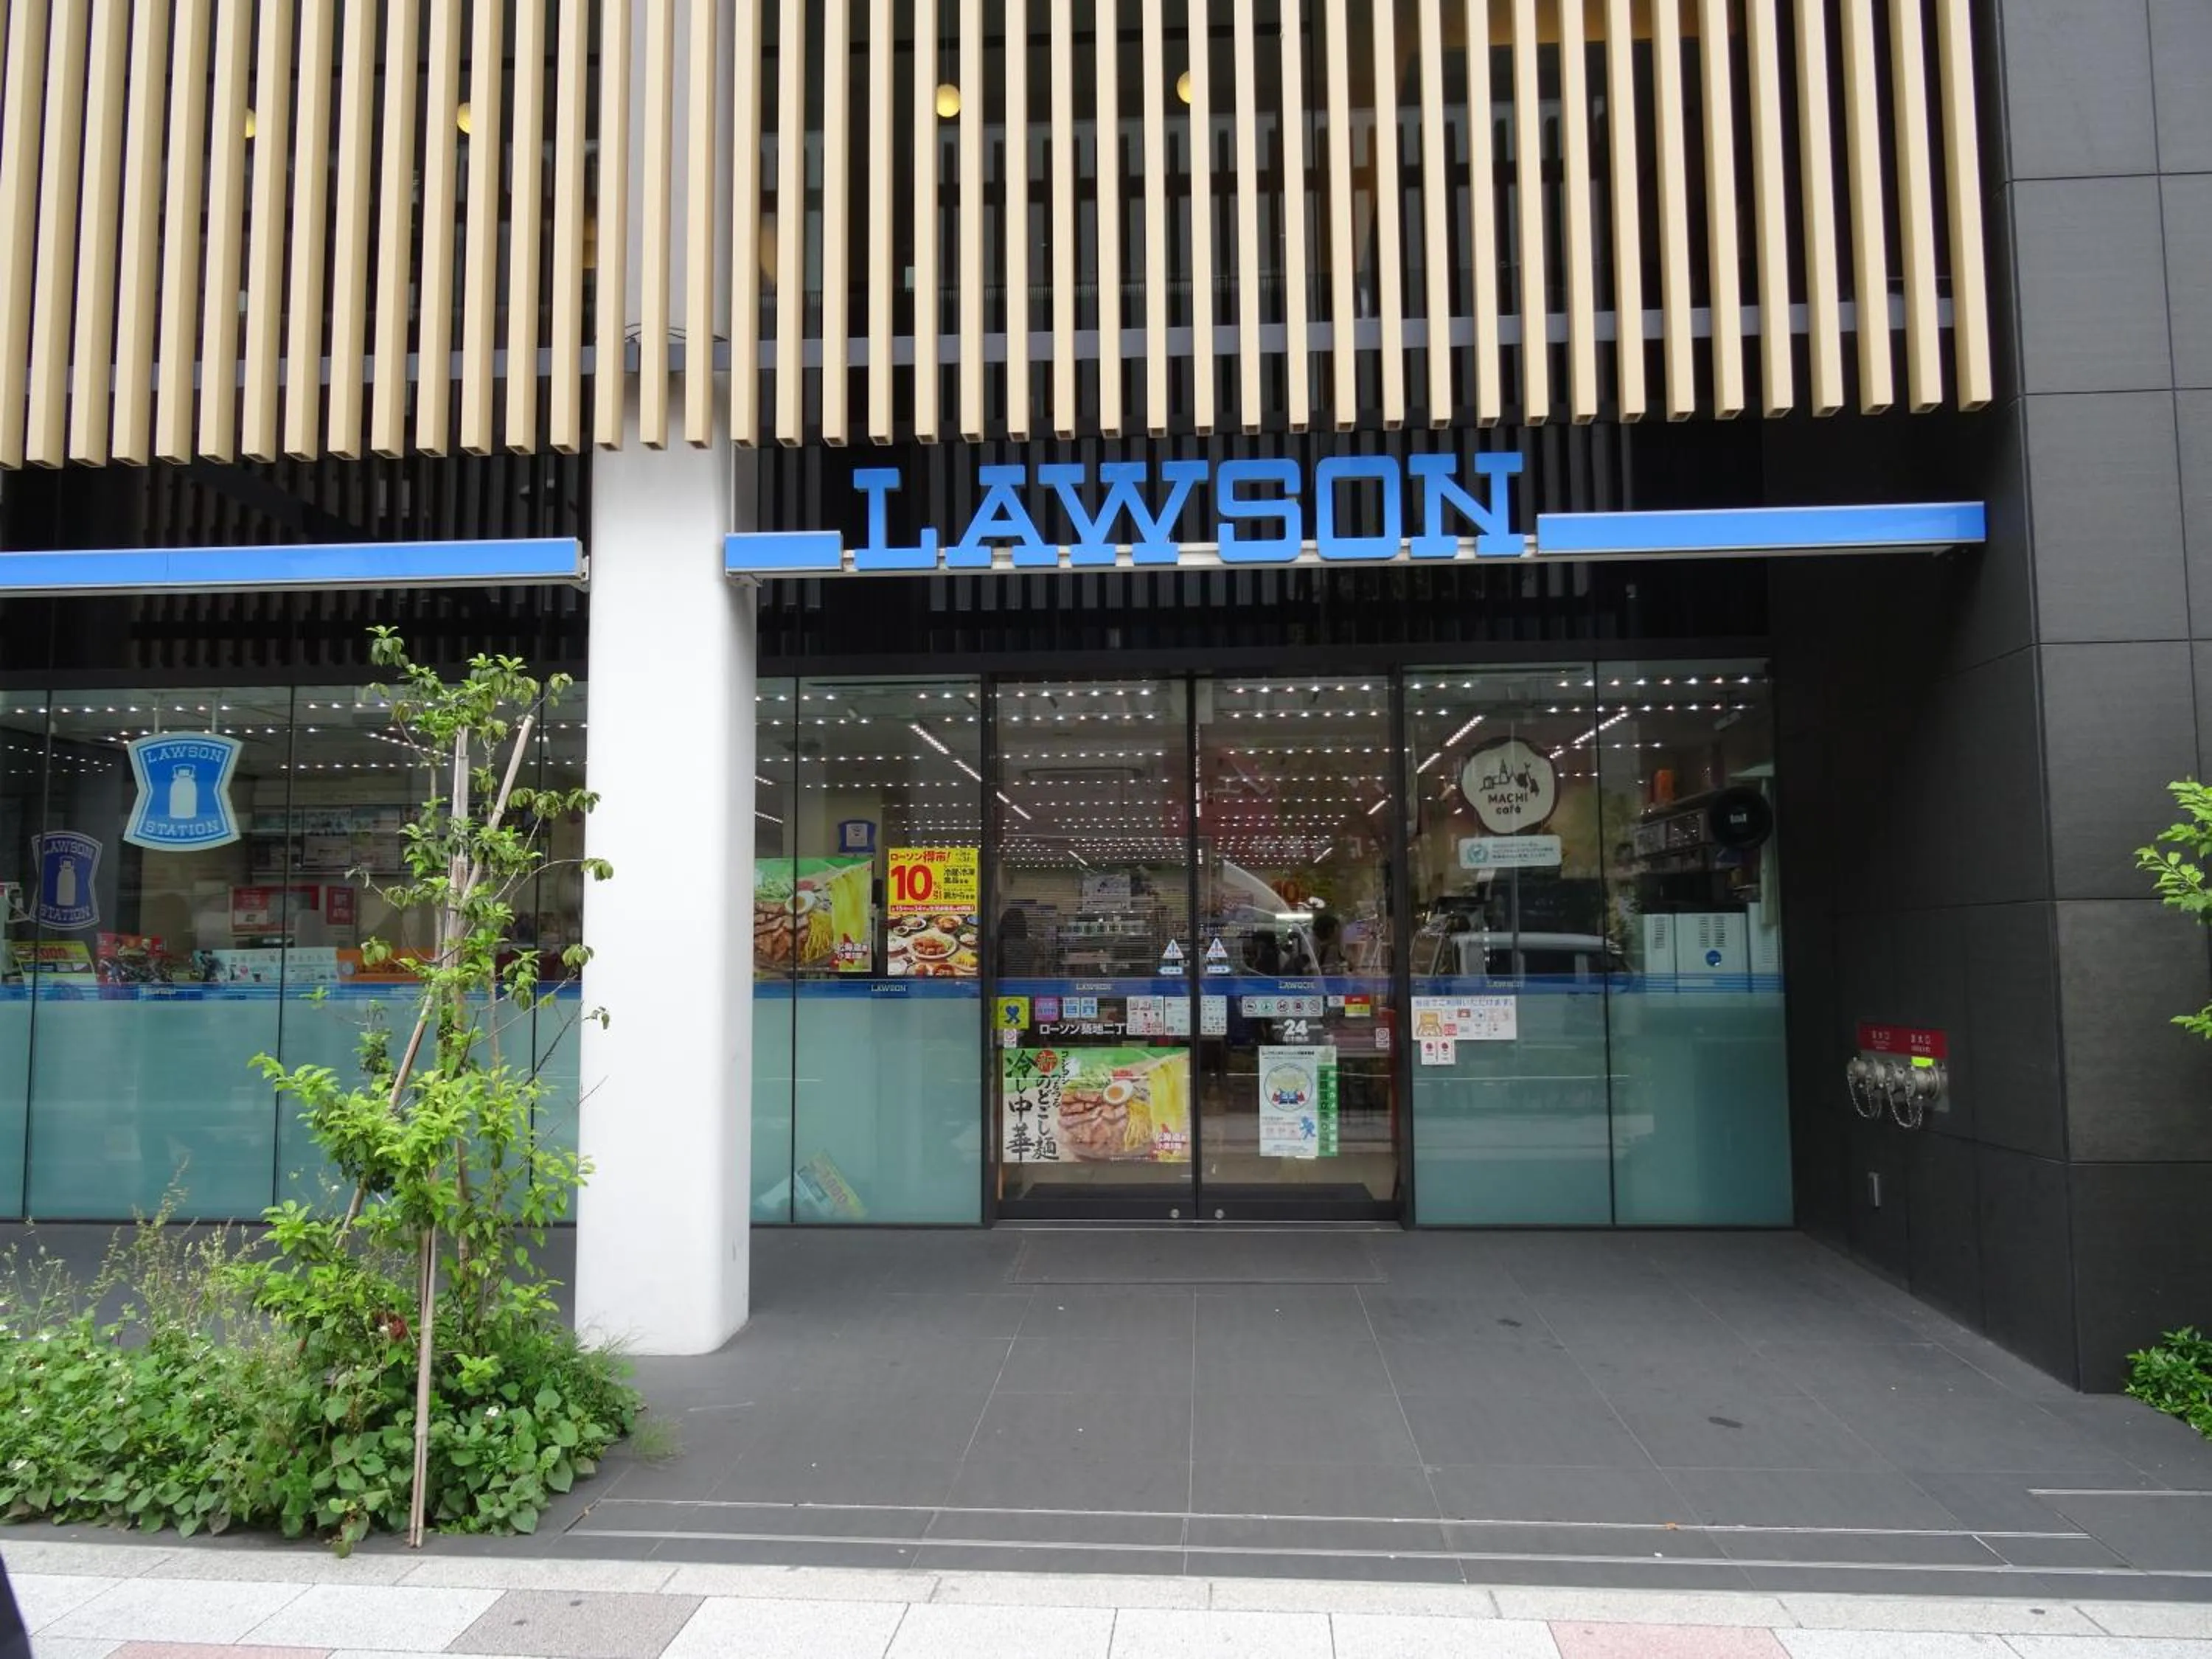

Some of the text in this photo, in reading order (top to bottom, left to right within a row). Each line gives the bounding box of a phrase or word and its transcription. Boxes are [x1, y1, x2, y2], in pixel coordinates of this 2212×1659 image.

[853, 451, 1524, 571] LAWSON
[146, 745, 224, 763] LAWSON
[1488, 793, 1528, 803] MACHI
[145, 818, 220, 837] STATION
[44, 840, 94, 859] LAWSON
[890, 864, 933, 901] 10
[39, 905, 91, 922] STATION
[1283, 1019, 1308, 1035] 24
[1005, 1050, 1038, 1163] 冷し中華
[1032, 1075, 1060, 1161] のどごし麺
